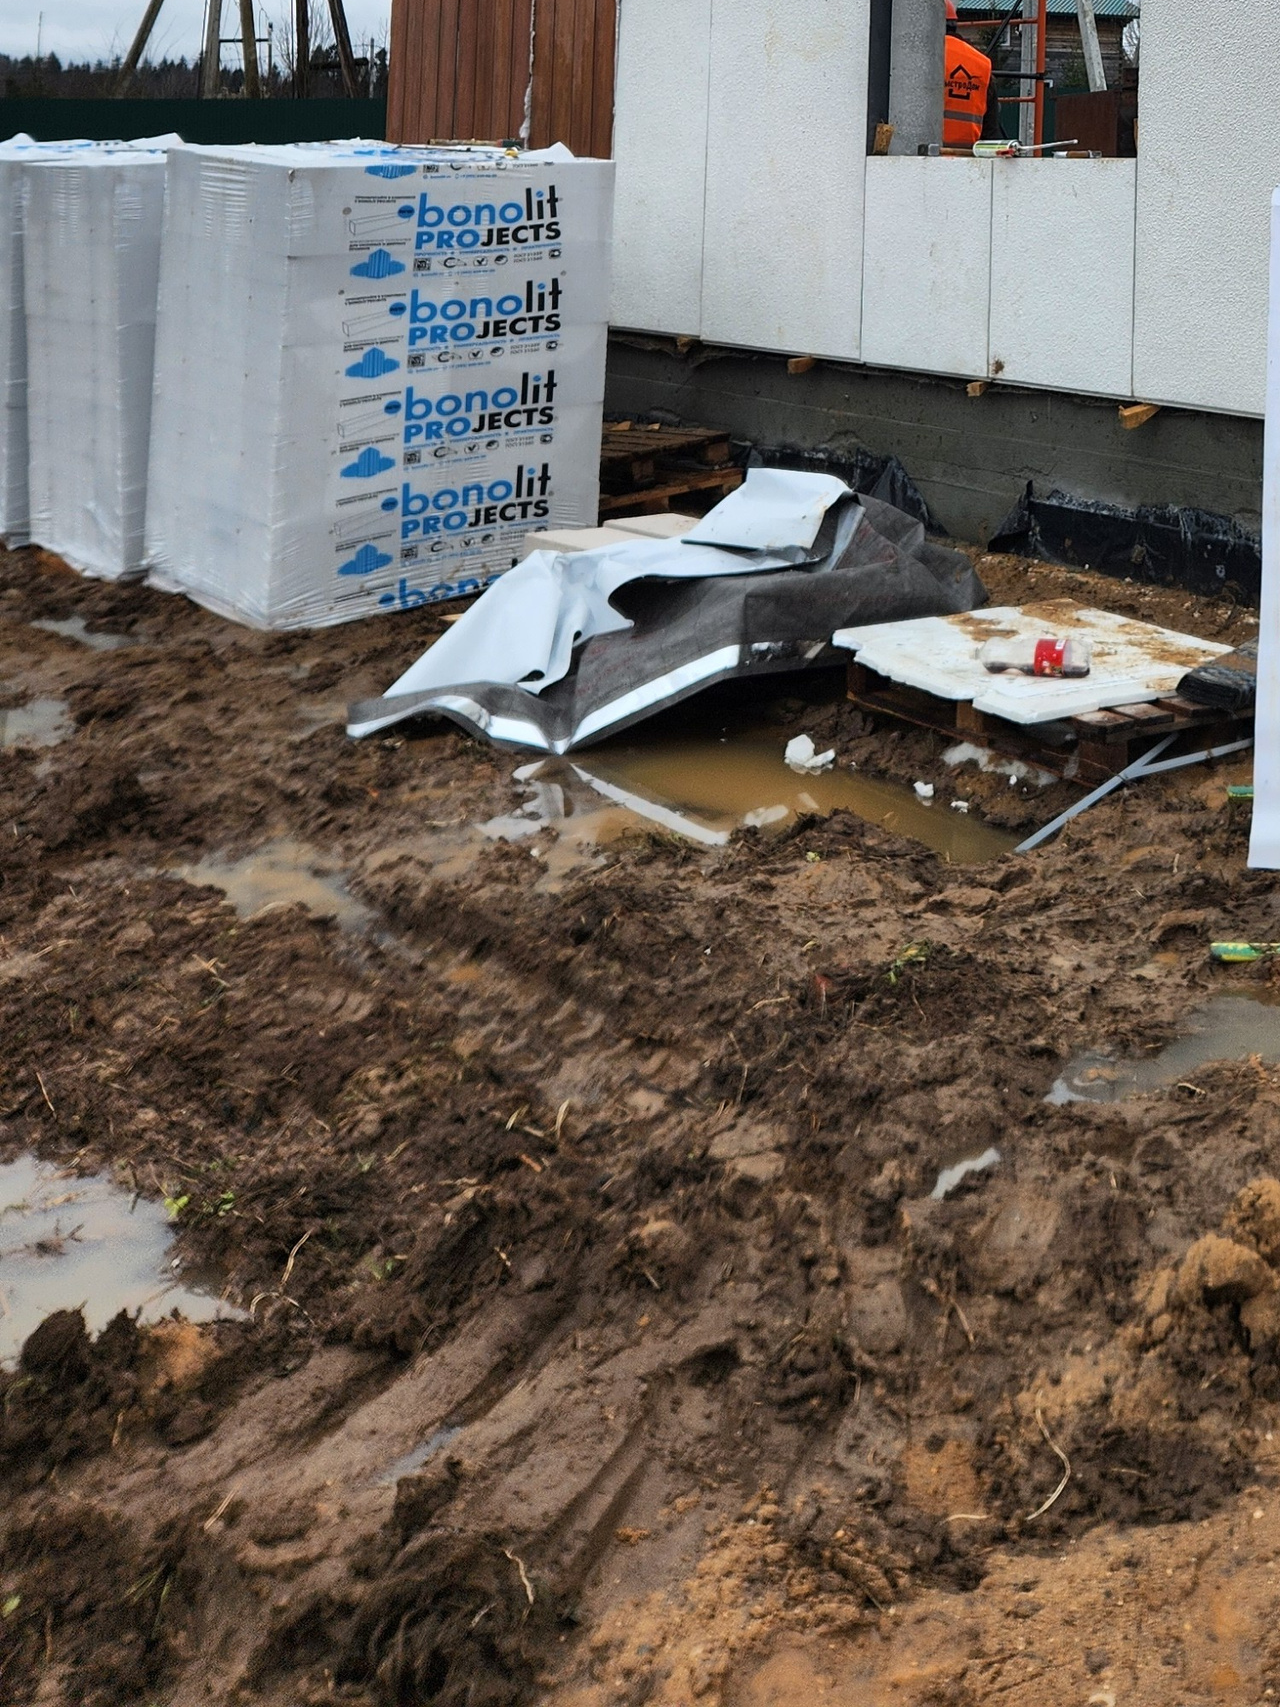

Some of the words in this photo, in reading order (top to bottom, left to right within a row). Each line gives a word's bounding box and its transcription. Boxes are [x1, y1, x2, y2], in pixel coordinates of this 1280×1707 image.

[417, 185, 559, 228] bonolit
[415, 221, 561, 250] PROJECTS
[409, 278, 562, 324] bonolit
[408, 313, 561, 346] PROJECTS
[404, 370, 557, 421] bonolit
[403, 406, 554, 443] PROJECTS
[401, 462, 551, 517] bonolit
[401, 499, 549, 539] PROJECTS
